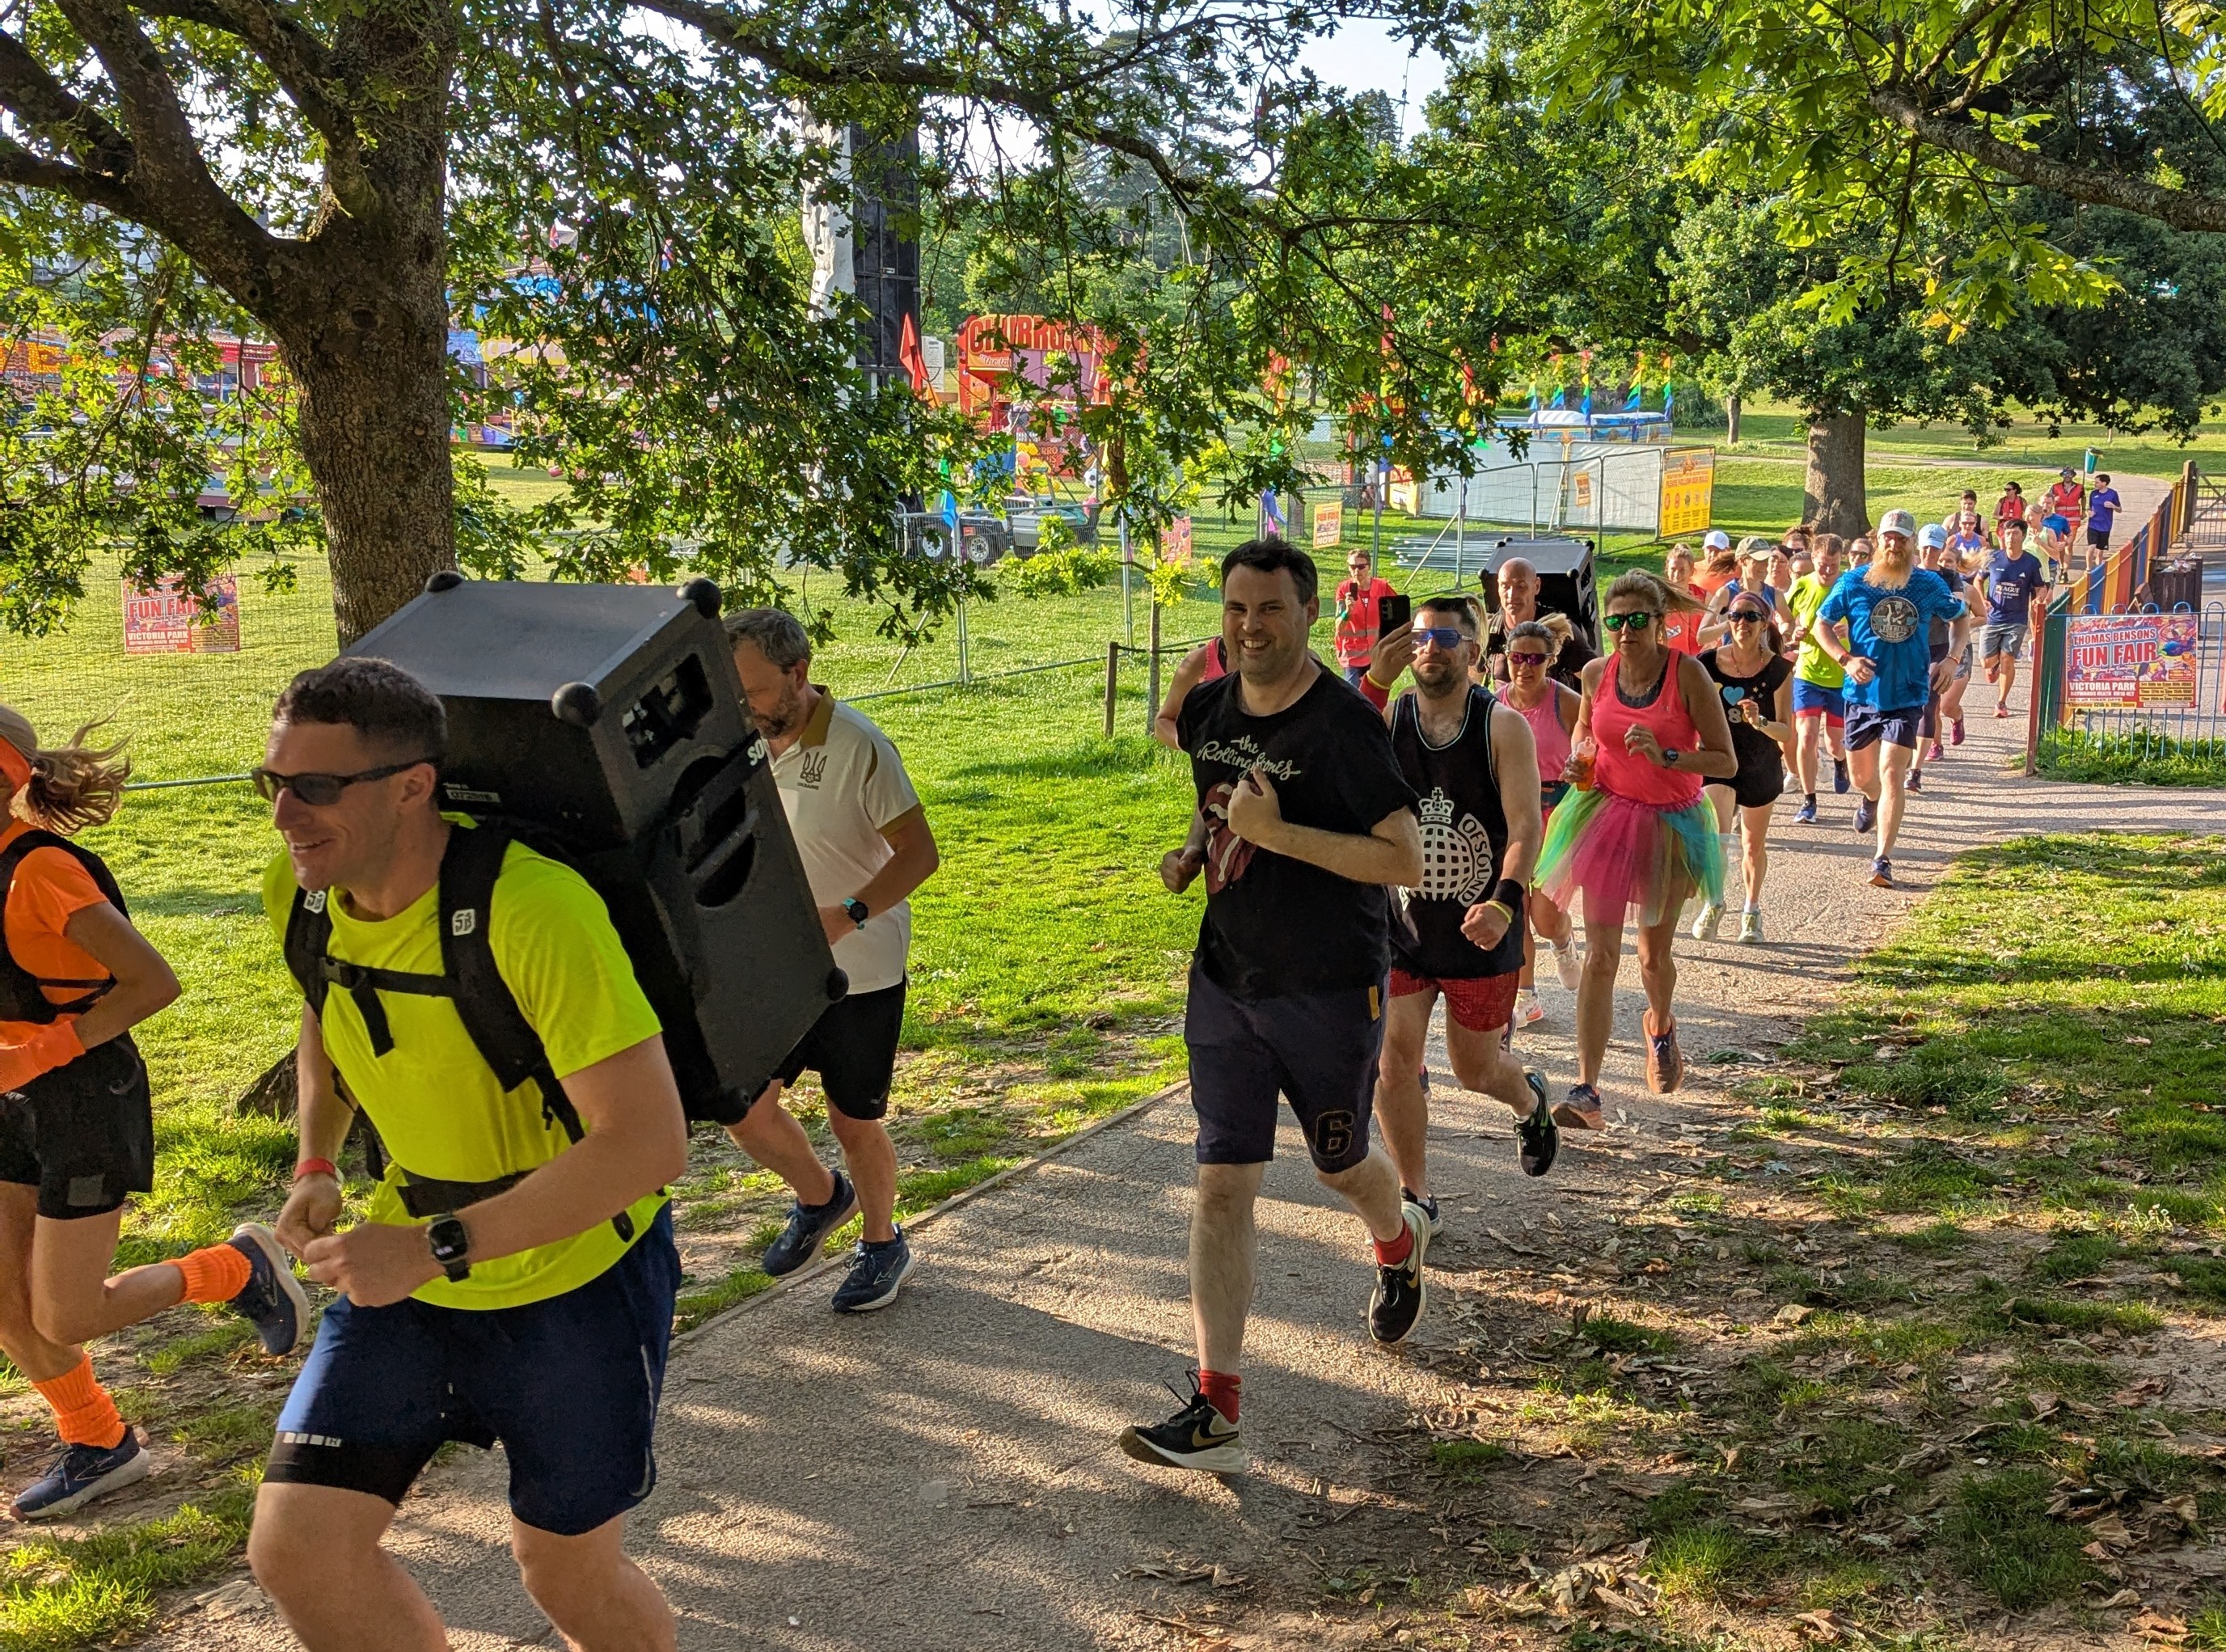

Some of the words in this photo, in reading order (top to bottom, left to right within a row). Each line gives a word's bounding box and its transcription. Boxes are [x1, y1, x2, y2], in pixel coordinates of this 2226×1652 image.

[129, 598, 163, 620] FUN
[127, 632, 167, 641] VICTORIA
[167, 630, 189, 640] PARK
[2072, 632, 2111, 646] THOMAS
[2113, 628, 2156, 642] BENSONS
[2072, 645, 2109, 668] FUN
[2114, 641, 2156, 664] FAIR
[2069, 682, 2111, 691] VICTORIA
[2112, 682, 2136, 691] PARK
[1230, 733, 1260, 754] the
[1196, 740, 1254, 781] Rolling
[1315, 1109, 1354, 1159] 6
